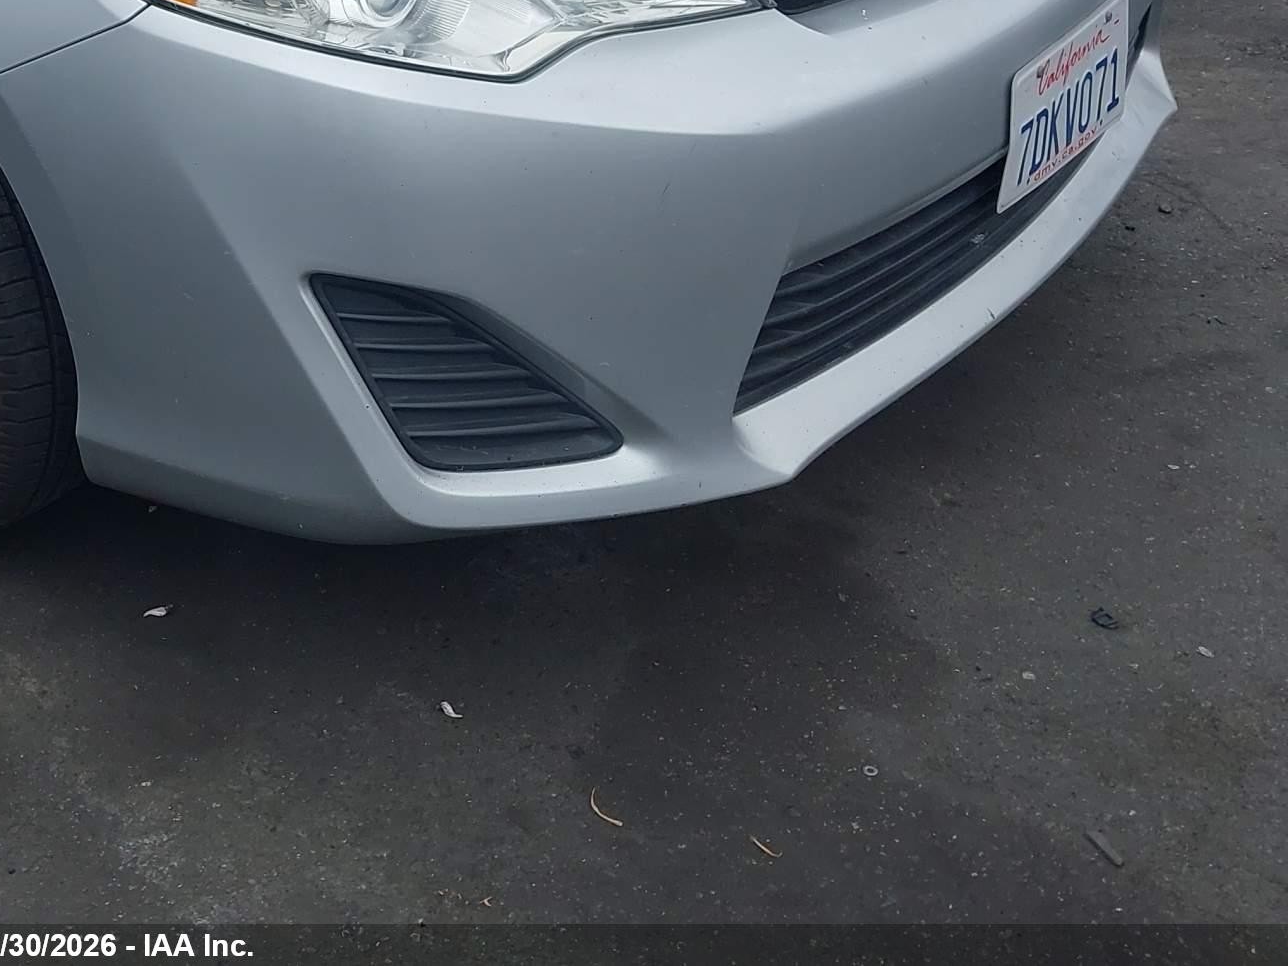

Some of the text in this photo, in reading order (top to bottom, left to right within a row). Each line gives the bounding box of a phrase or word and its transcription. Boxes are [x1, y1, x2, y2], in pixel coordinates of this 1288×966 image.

[1037, 28, 1110, 95] California
[1017, 48, 1119, 186] 7DKV071
[1033, 127, 1098, 181] dmv.ca.gov
